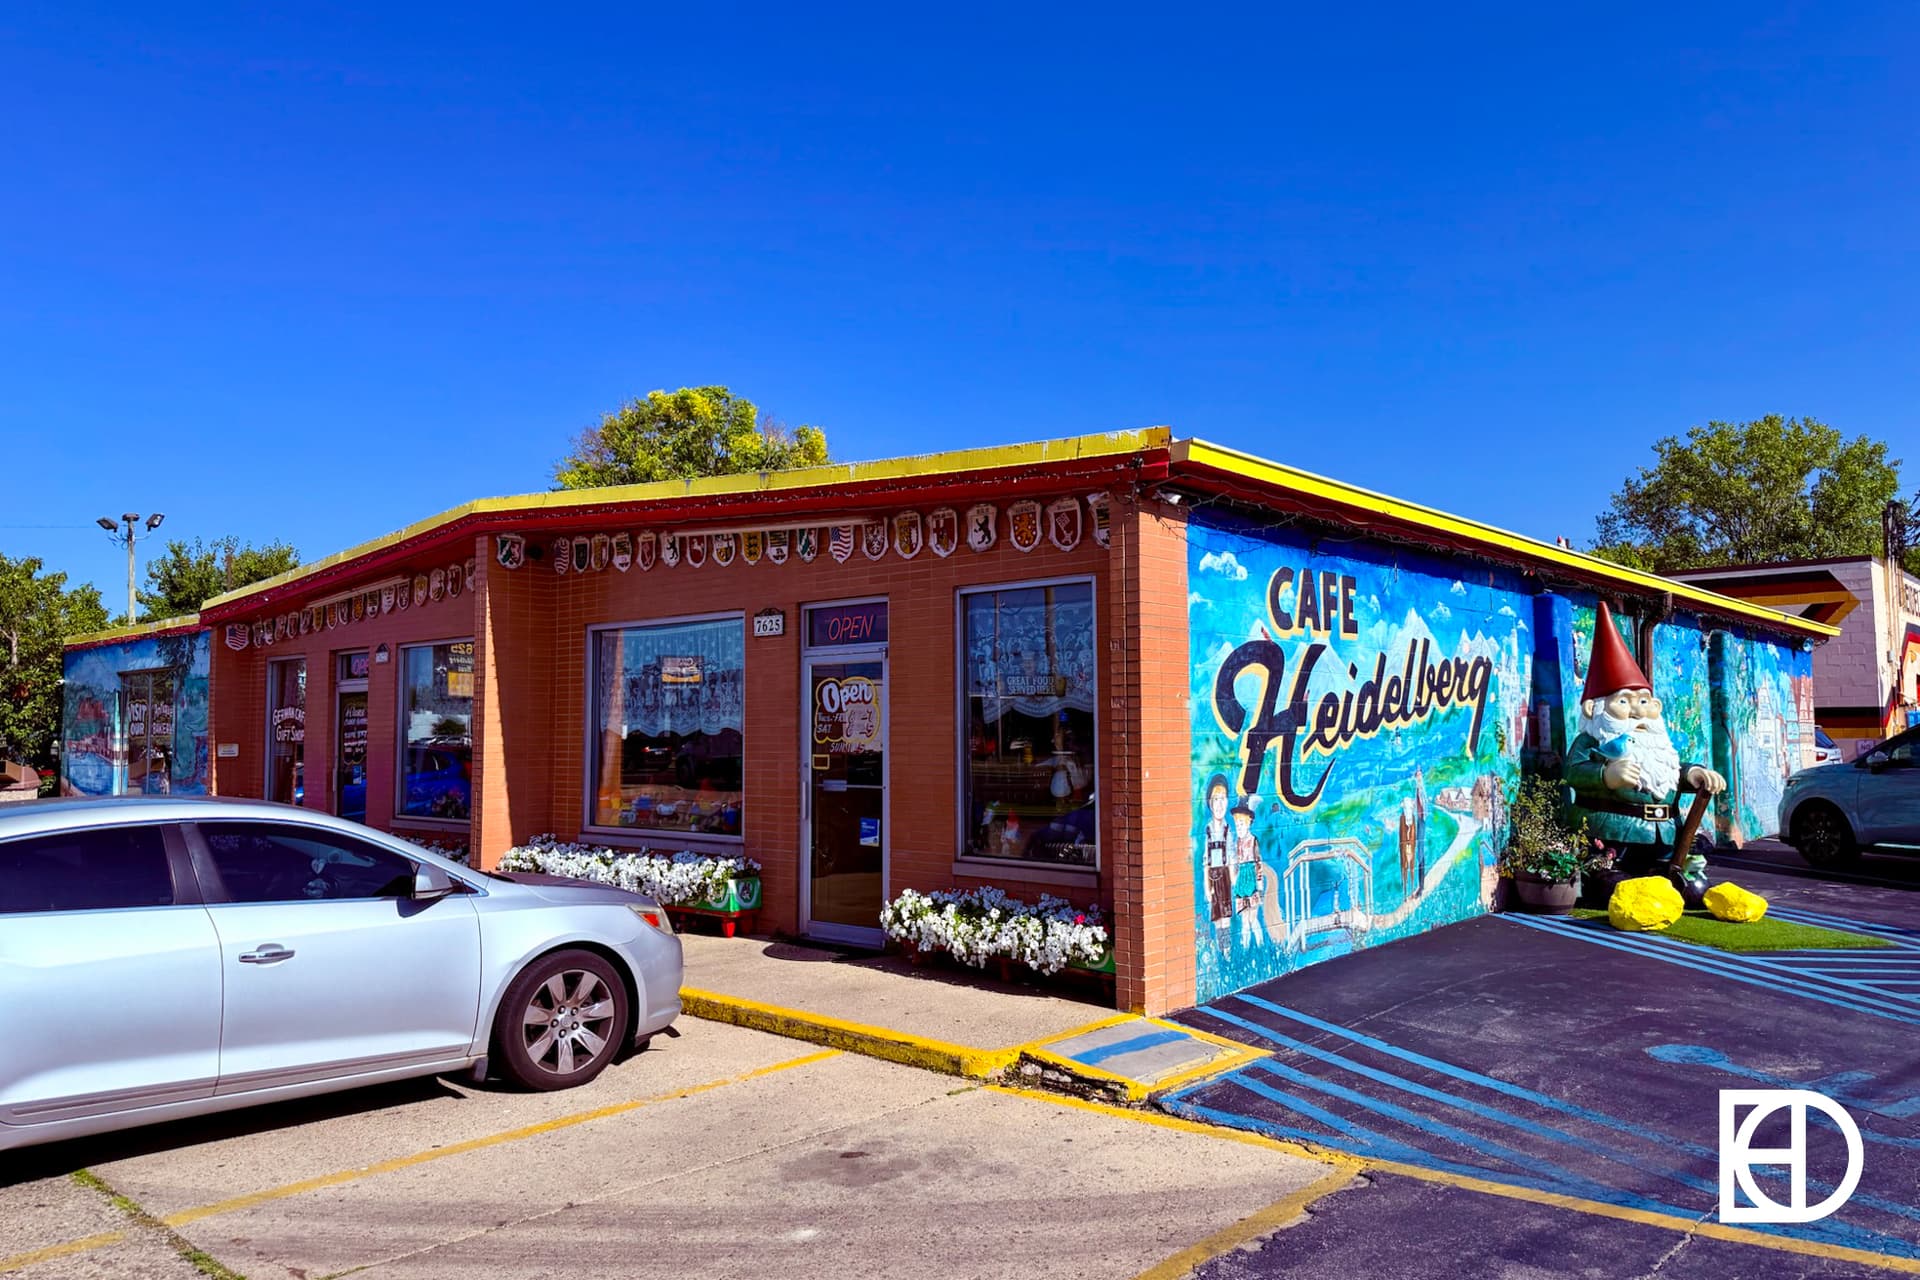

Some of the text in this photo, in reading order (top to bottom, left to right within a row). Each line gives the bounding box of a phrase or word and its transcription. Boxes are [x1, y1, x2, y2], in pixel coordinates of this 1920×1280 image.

[1266, 566, 1358, 640] CAFE
[756, 619, 780, 633] 7625
[828, 614, 874, 641] OPEN
[351, 657, 368, 675] OPE
[1007, 675, 1055, 686] GREAT FOOD
[822, 682, 872, 713] Open
[1008, 685, 1056, 695] SERVED HERE
[128, 703, 147, 721] VISIT
[273, 706, 295, 726] GERMAN
[130, 722, 145, 736] OUR
[276, 725, 290, 741] GIFT
[1212, 638, 1493, 813] Heidelberg
